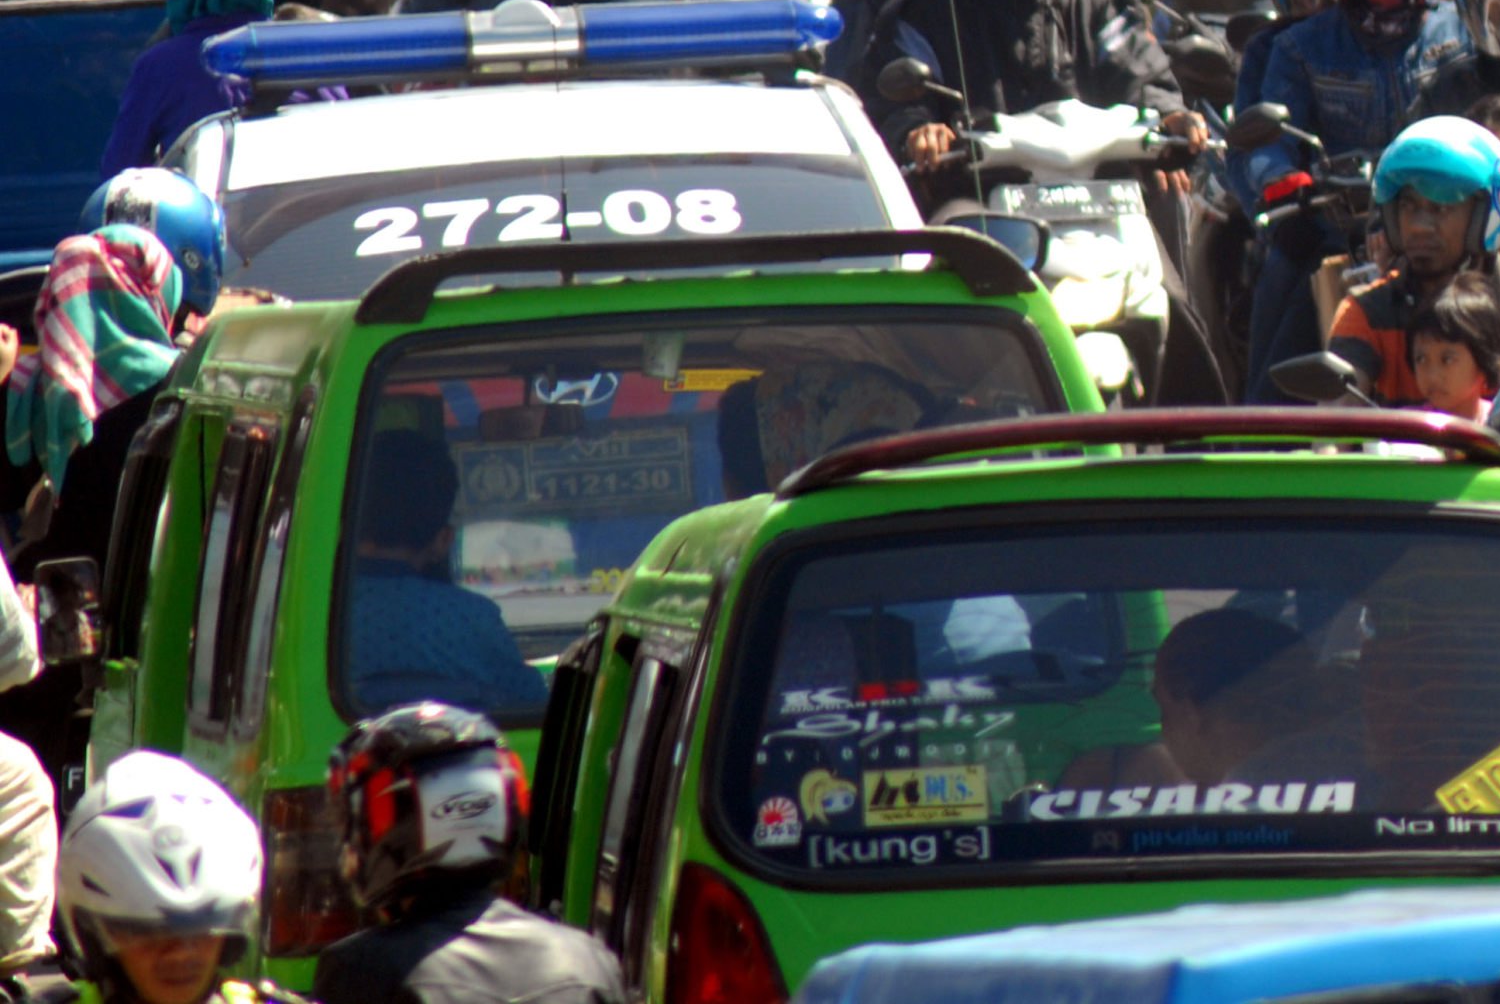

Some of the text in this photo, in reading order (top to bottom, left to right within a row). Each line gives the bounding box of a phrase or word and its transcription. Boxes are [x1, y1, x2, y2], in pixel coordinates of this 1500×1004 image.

[353, 188, 742, 257] 272-08
[543, 467, 671, 500] 1121-30
[1029, 781, 1356, 822] CISARUA
